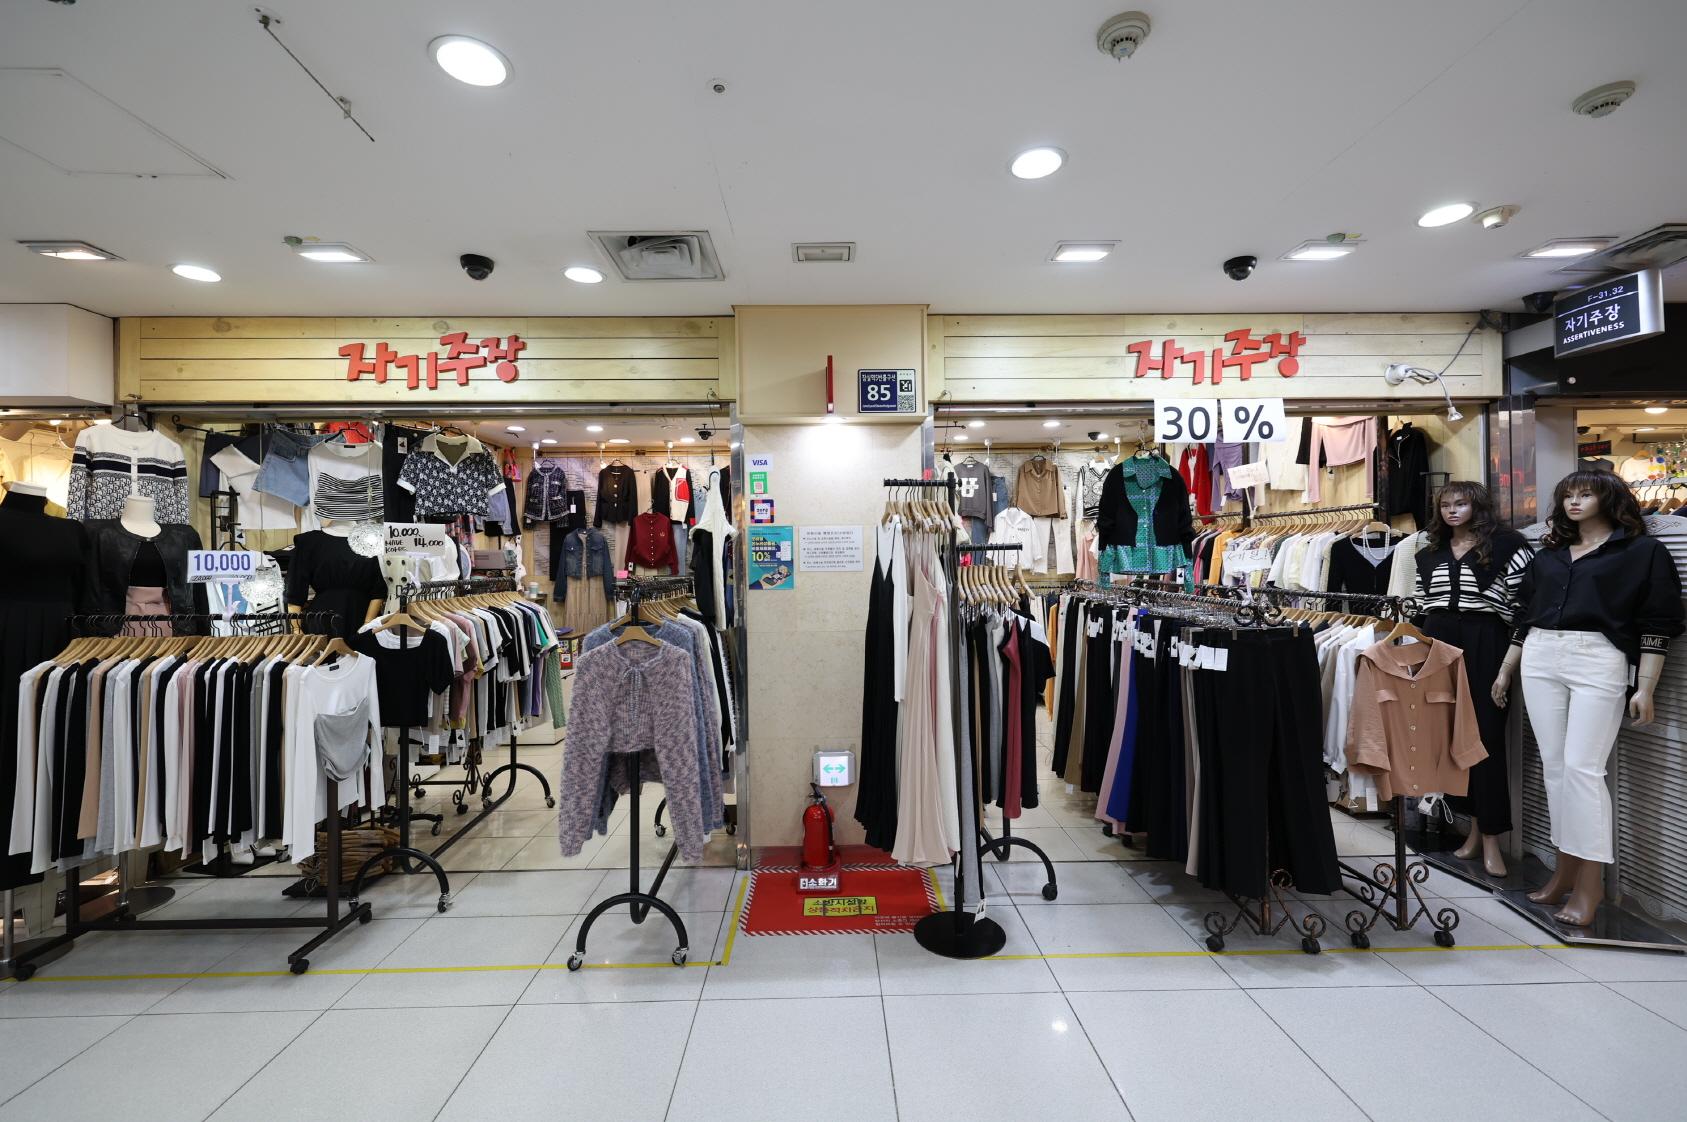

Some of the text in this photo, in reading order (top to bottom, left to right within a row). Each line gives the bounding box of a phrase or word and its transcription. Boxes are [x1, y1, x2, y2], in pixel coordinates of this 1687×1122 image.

[1564, 303, 1621, 332] 자기주장
[1563, 321, 1625, 345] ASSERTIVENESS
[338, 331, 527, 390] 자기주장
[1127, 328, 1307, 385] 자기주장
[867, 384, 891, 401] 85
[1162, 404, 1274, 440] 30 %
[193, 553, 251, 572] 10,000
[808, 877, 837, 888] 소화기
